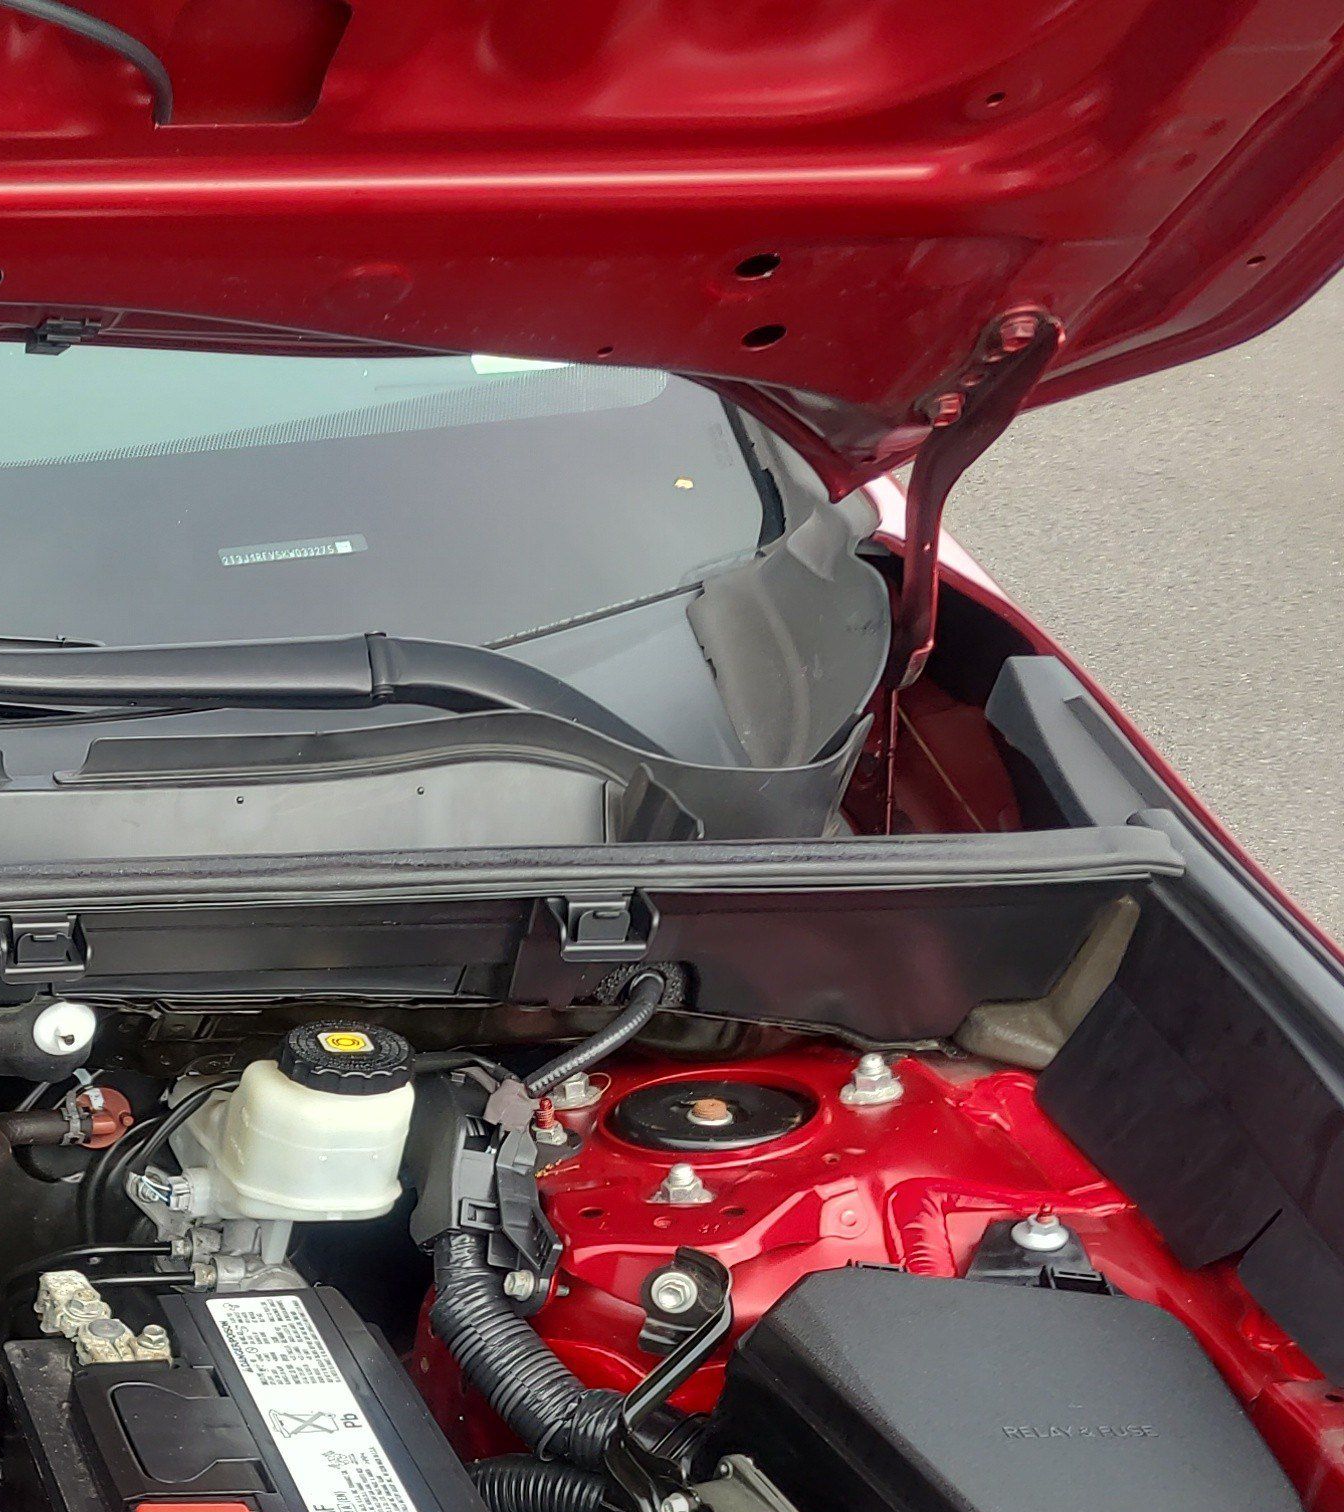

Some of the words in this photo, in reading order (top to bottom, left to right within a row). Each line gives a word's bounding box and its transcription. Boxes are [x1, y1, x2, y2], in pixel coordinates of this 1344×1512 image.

[339, 1413, 363, 1429] Pb
[1001, 1424, 1072, 1440] RELAY
[1098, 1424, 1160, 1439] FUSE
